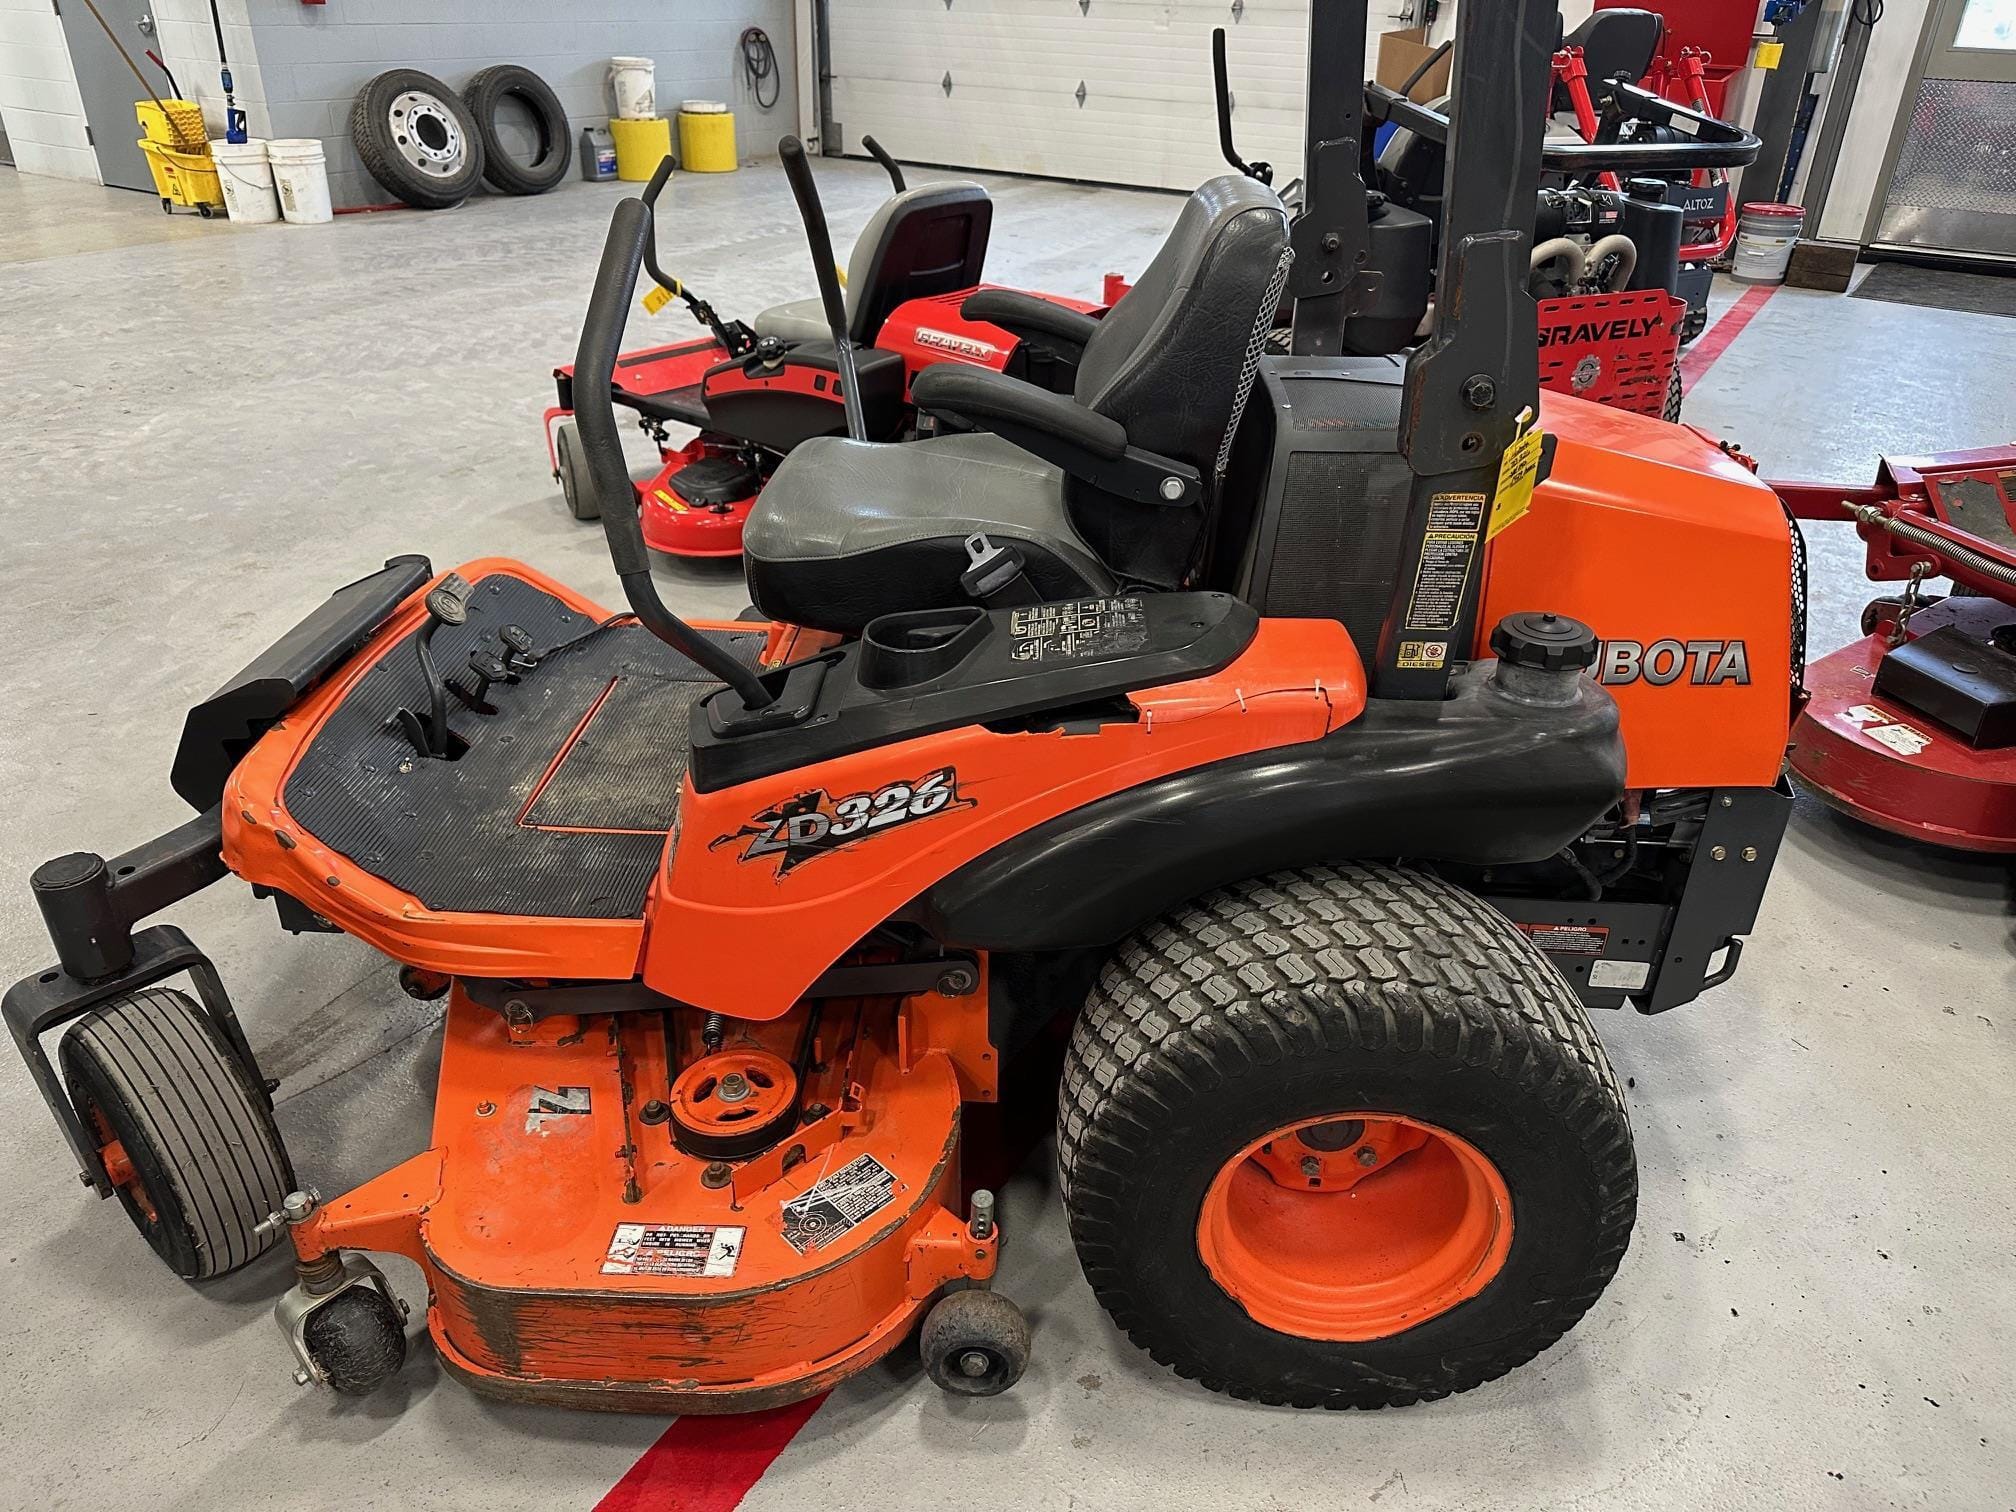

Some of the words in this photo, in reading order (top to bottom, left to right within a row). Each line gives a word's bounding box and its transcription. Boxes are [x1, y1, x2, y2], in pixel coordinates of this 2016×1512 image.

[1683, 198, 1714, 211] ALTOZ
[1584, 638, 1752, 686] BOTA
[740, 772, 954, 861] ZD326
